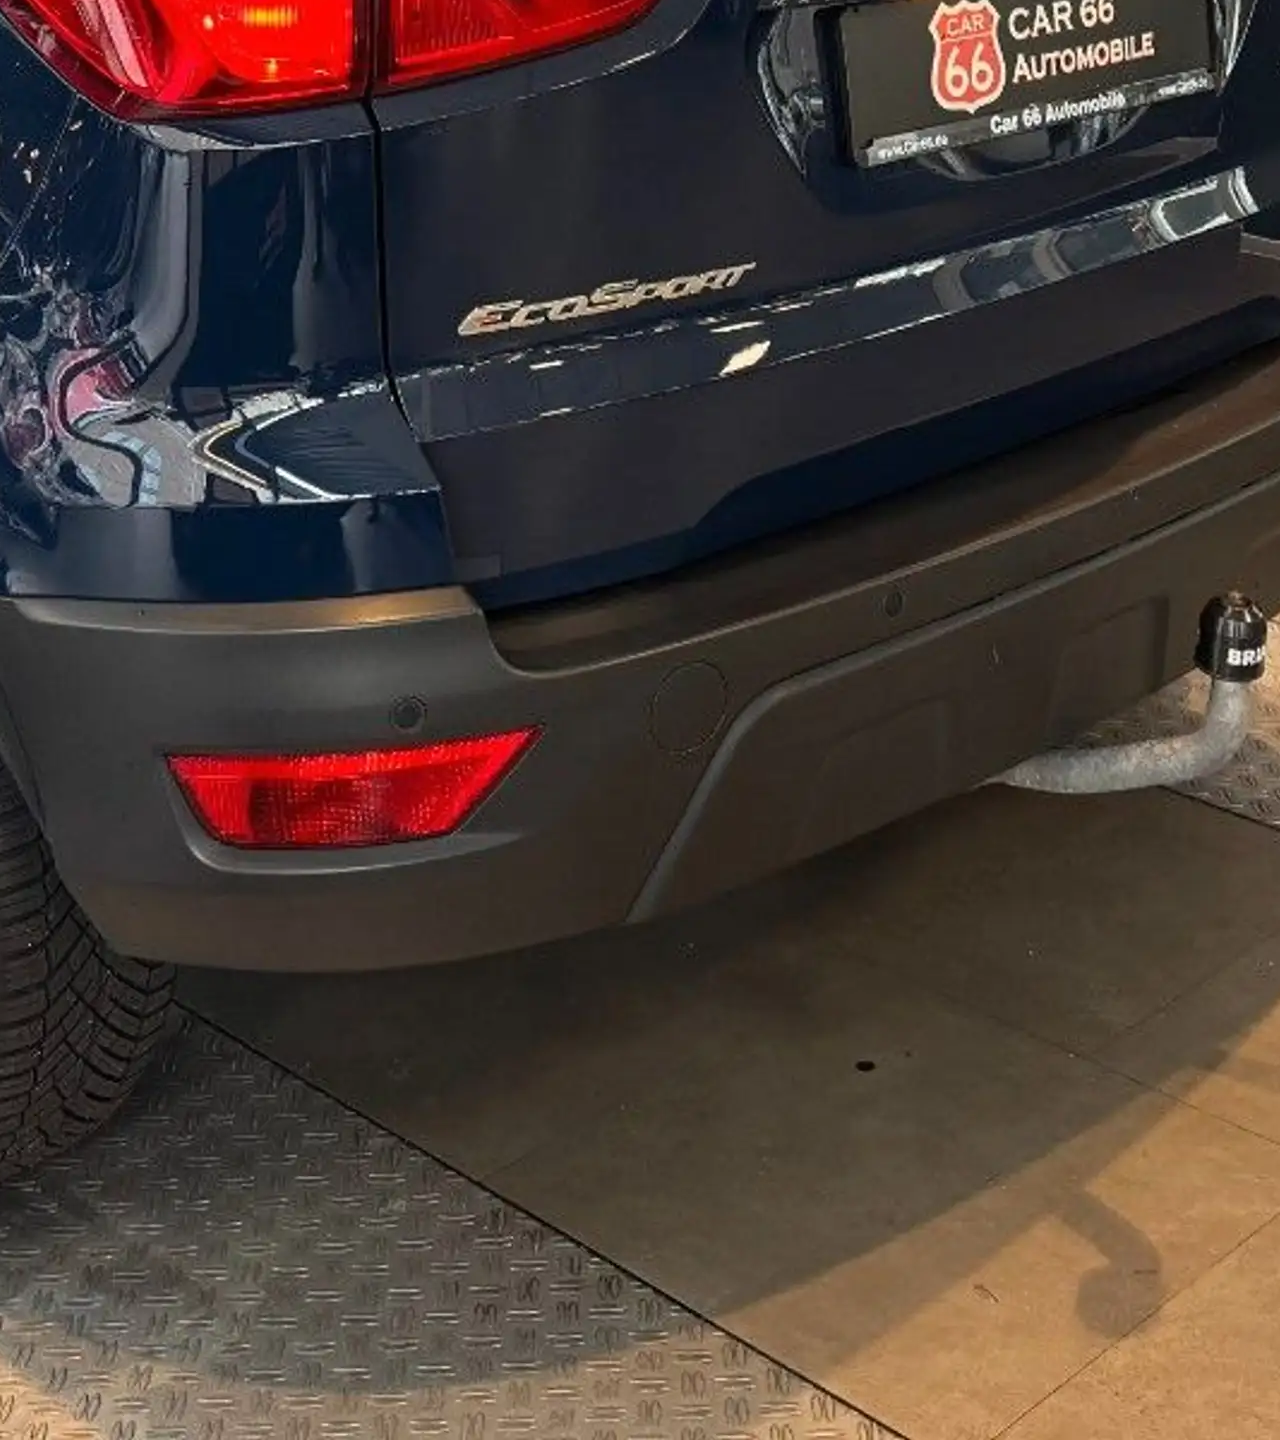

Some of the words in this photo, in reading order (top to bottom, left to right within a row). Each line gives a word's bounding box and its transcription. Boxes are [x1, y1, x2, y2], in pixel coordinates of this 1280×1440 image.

[945, 16, 988, 38] CAR
[1008, 3, 1074, 41] CAR
[944, 43, 996, 98] 66
[990, 114, 1019, 135] Car
[1021, 103, 1042, 128] 66
